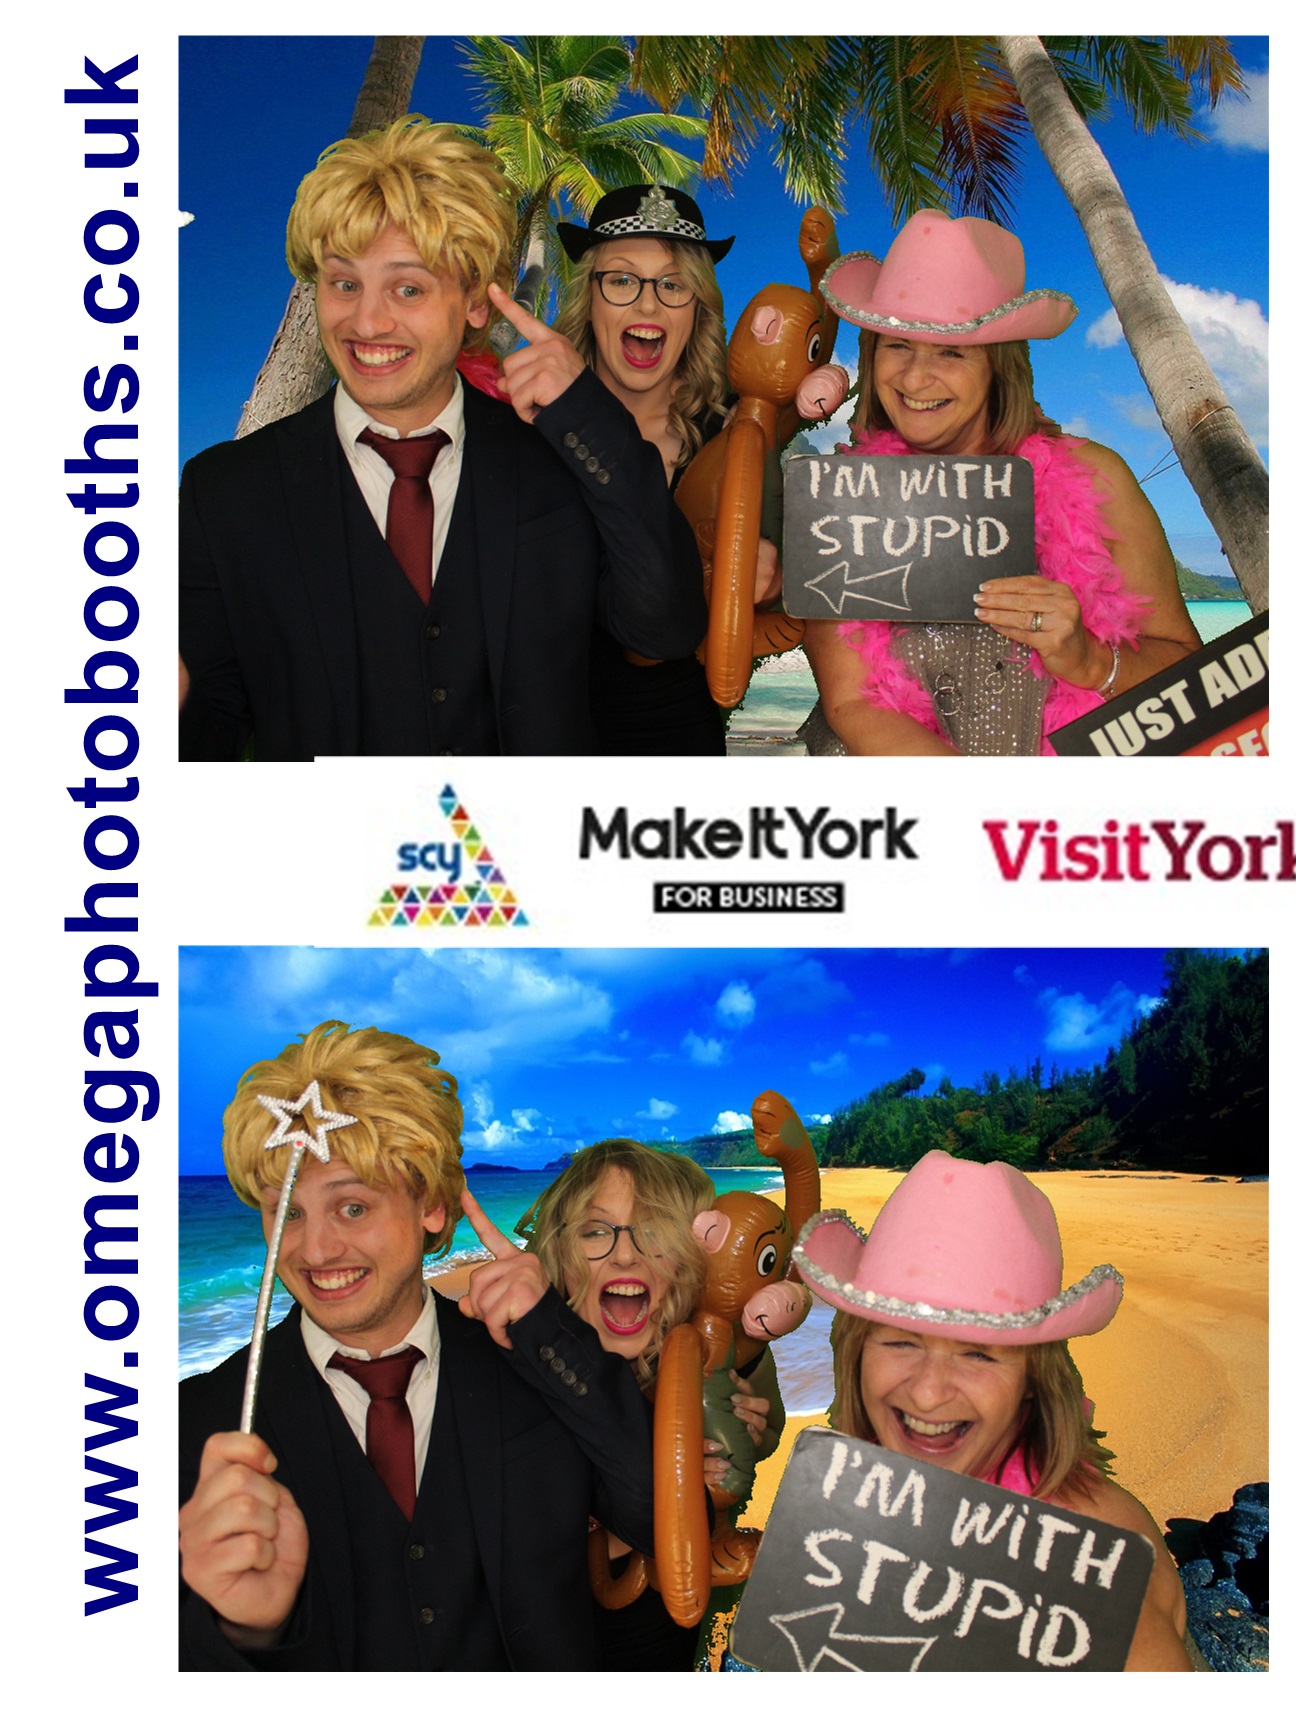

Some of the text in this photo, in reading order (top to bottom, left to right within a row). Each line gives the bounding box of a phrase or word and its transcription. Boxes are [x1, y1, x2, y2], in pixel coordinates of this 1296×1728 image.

[809, 460, 880, 498] I'M
[1089, 679, 1196, 756] JUST
[822, 1441, 926, 1526] I'M
